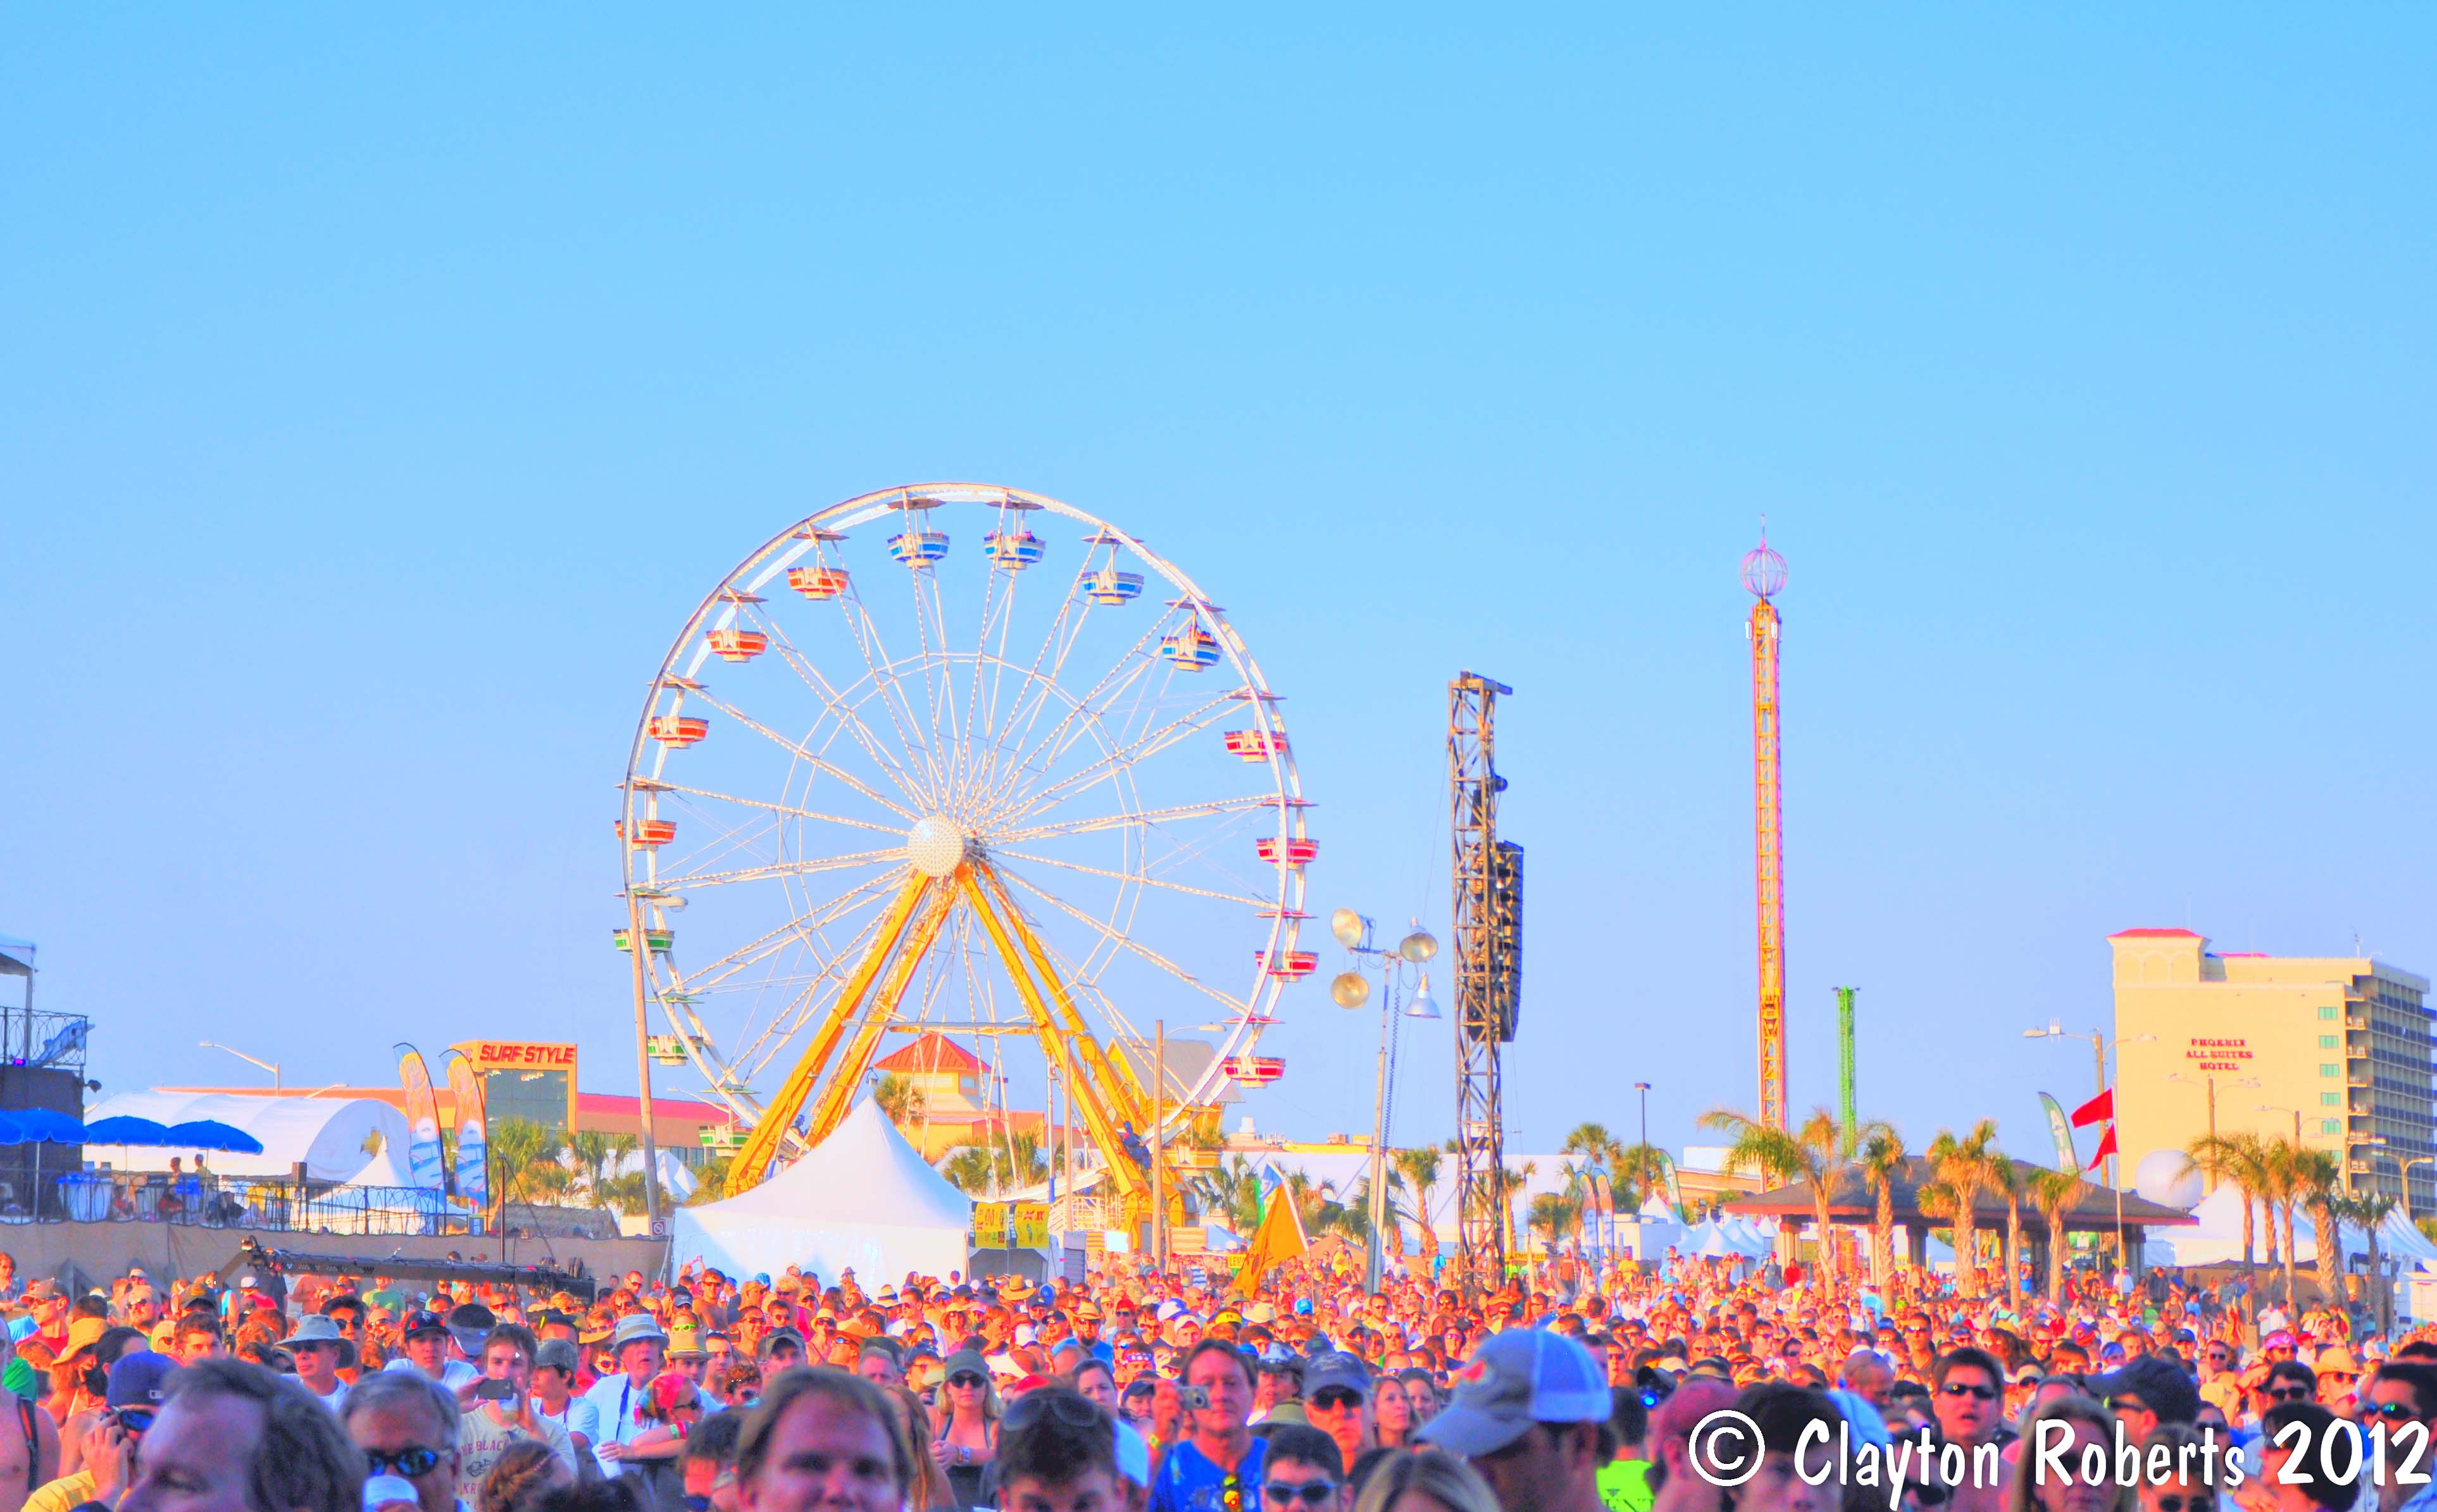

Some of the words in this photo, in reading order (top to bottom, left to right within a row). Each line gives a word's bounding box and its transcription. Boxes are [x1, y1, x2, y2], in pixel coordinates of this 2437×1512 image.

[2191, 1038, 2246, 1047] PHOENIX
[480, 1044, 524, 1063] SURF
[524, 1046, 576, 1064] STYLE
[2186, 1050, 2208, 1058] ALL
[2210, 1050, 2253, 1059] SUITES
[2199, 1062, 2240, 1070] HOTEL
